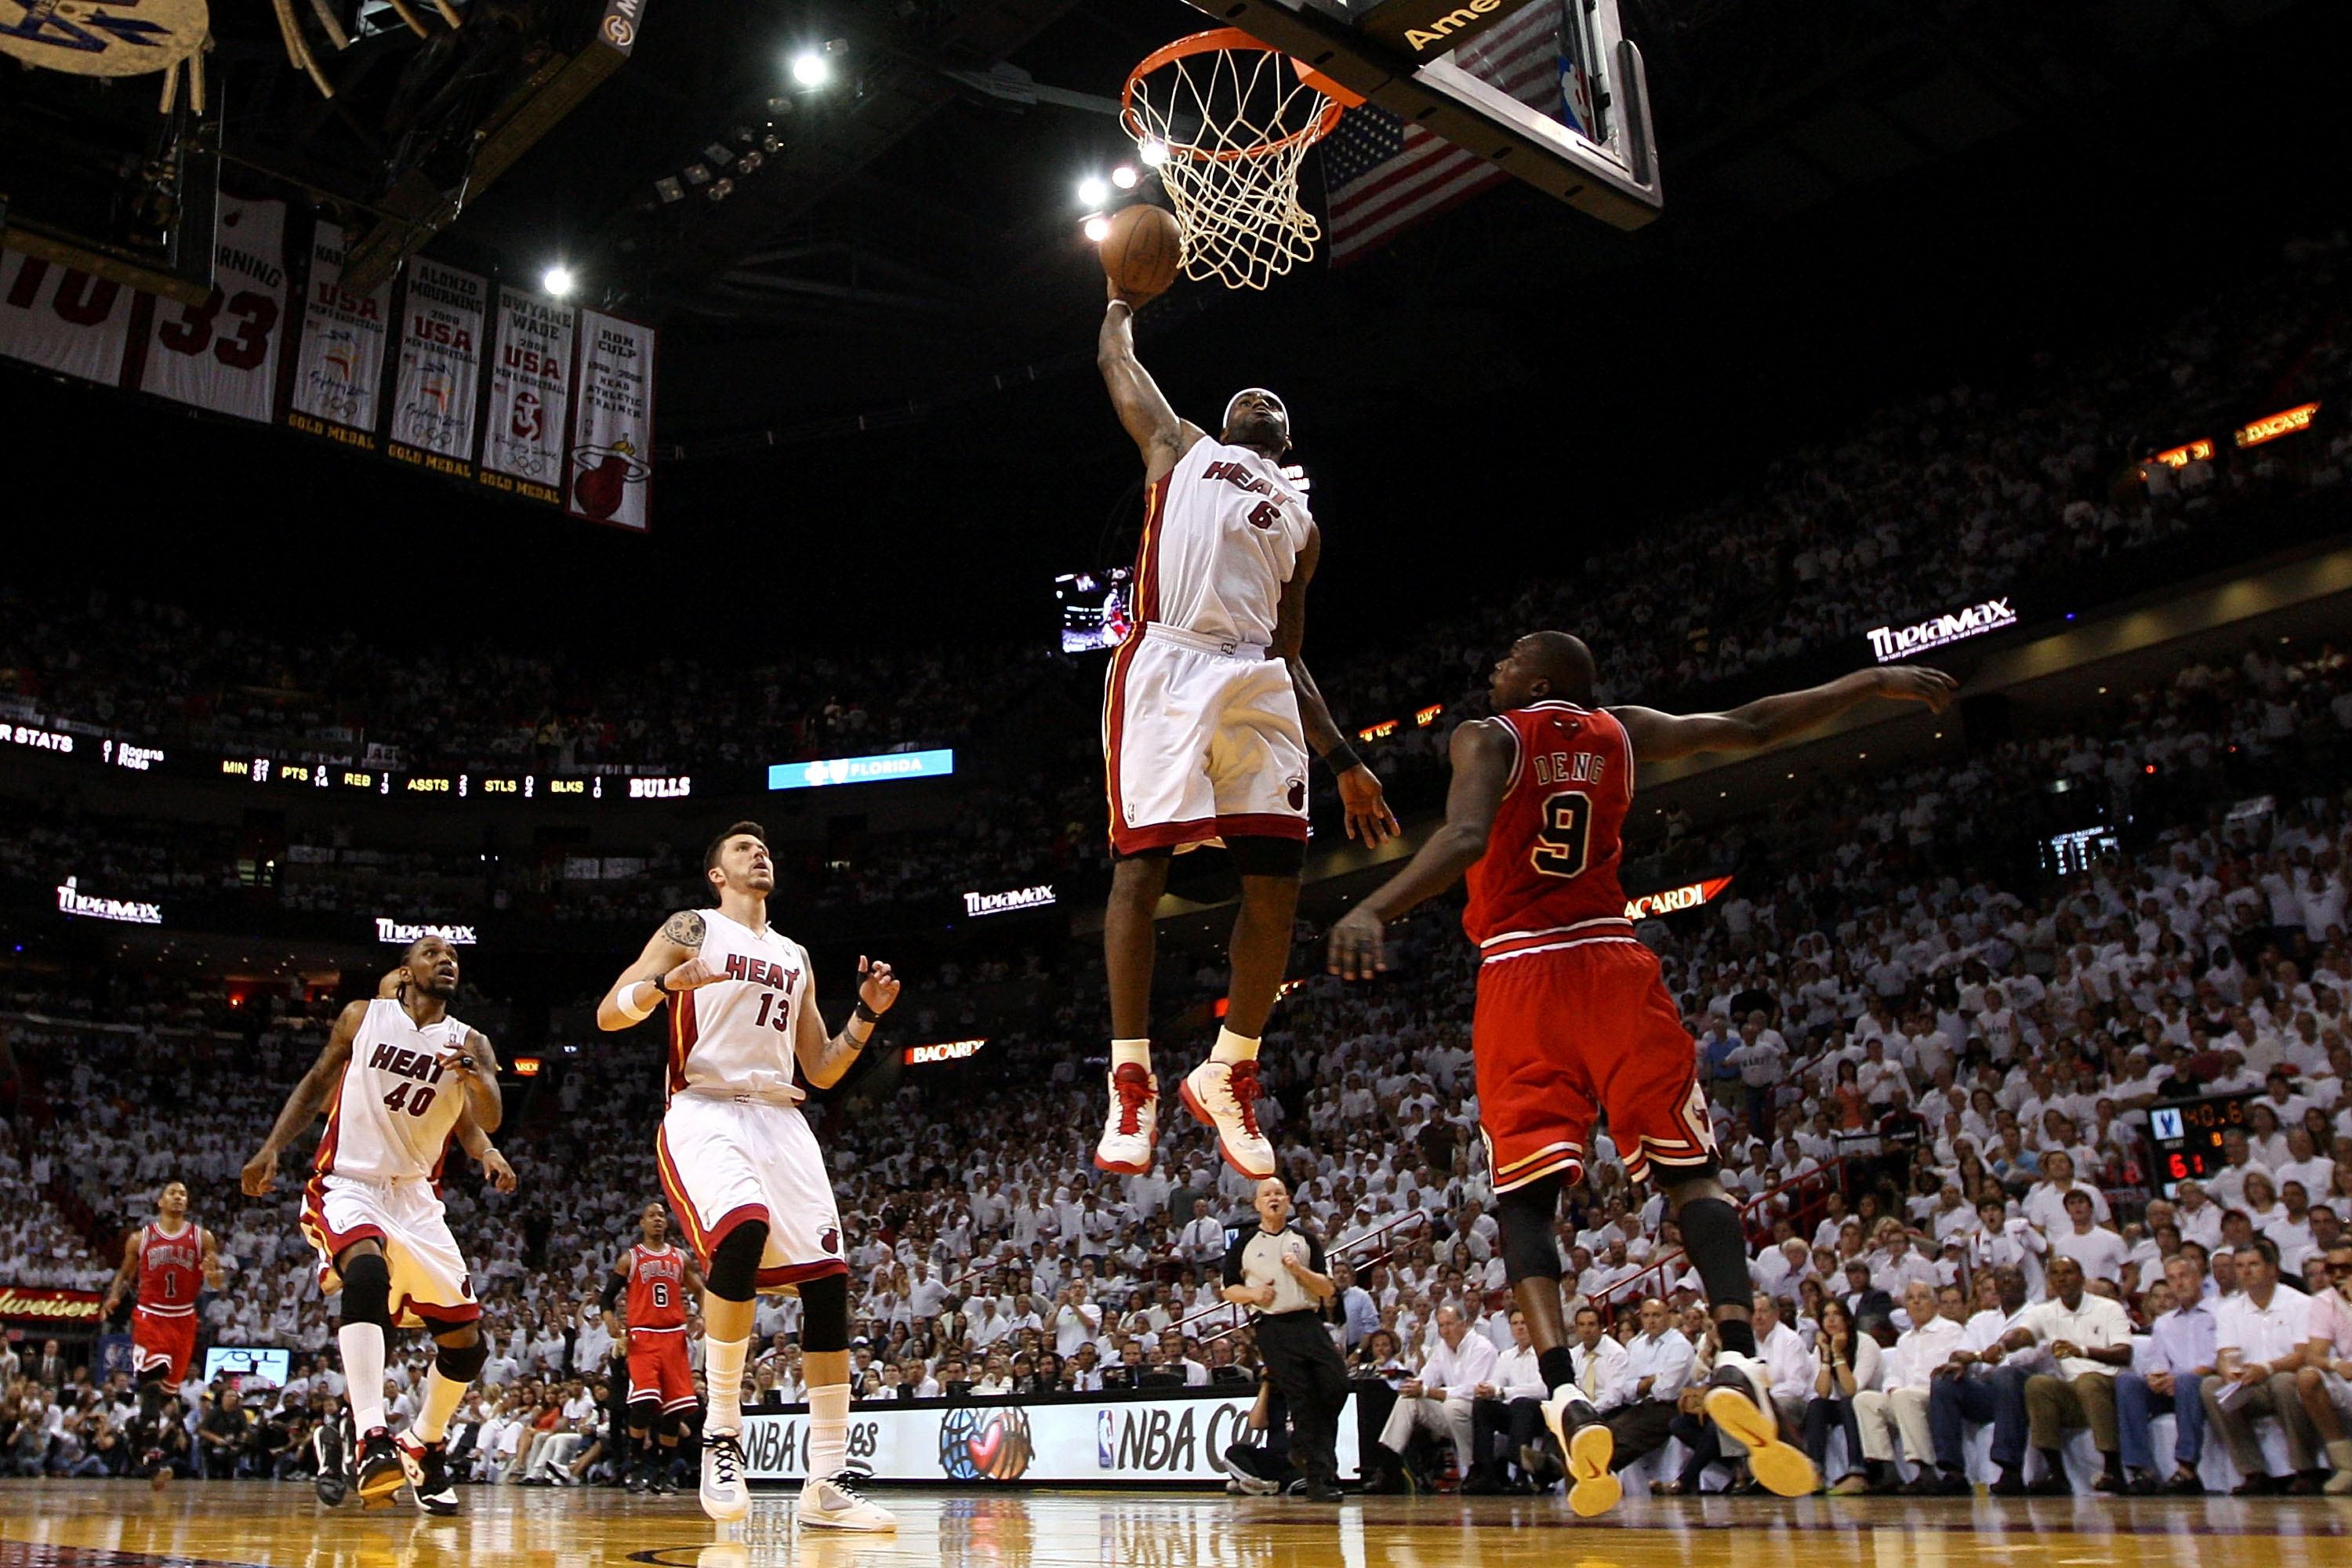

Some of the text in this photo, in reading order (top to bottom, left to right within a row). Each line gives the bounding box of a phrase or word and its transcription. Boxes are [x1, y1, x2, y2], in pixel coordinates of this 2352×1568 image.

[420, 267, 477, 296] ALONZO
[319, 282, 378, 320] USA
[410, 280, 484, 315] MOURNING
[503, 293, 572, 328] DWYANE
[158, 282, 278, 371] 33
[416, 317, 472, 351] USA
[512, 311, 560, 339] WADE
[598, 340, 637, 359] CULP
[602, 329, 634, 347] RON
[505, 343, 560, 379] USA
[586, 383, 642, 407] ATHLETIC
[600, 376, 630, 391] HEAD
[586, 396, 641, 419] TRAINER
[288, 413, 376, 451] GOLD MEDAL
[388, 443, 472, 480] GOLD MEDAL
[479, 470, 561, 505] GOLD MEDAL
[1202, 461, 1298, 506] HEAT
[1247, 500, 1282, 530] 6
[14, 726, 74, 753] STATS
[119, 742, 165, 761] Bogans
[118, 754, 150, 771] Rose
[223, 760, 249, 775] MIN
[253, 758, 270, 772] 22
[281, 766, 309, 781] PTS
[850, 758, 923, 776] FLORIDA
[1534, 752, 1606, 786] DENG
[314, 775, 329, 787] 14
[343, 772, 371, 787] REB
[380, 782, 390, 794] 3
[383, 772, 390, 782] 1
[407, 779, 449, 792] ASSTS
[459, 774, 468, 786] 2
[485, 779, 517, 793] STLS
[524, 775, 535, 786] 0
[550, 780, 584, 793] BLKS
[594, 776, 601, 787] 1
[629, 776, 691, 798] BULLS
[459, 785, 467, 797] 3
[524, 785, 534, 798] 2
[593, 786, 602, 798] 0
[1530, 790, 1593, 879] 9
[725, 953, 800, 995] HEAT
[754, 993, 790, 1033] 13
[383, 1081, 437, 1117] 40
[147, 1244, 195, 1272] BULLS
[639, 1260, 682, 1284] BULLS
[164, 1271, 176, 1298] 1
[652, 1283, 669, 1308] 6
[744, 1419, 796, 1472] NBA
[1118, 1406, 1196, 1472] NBA
